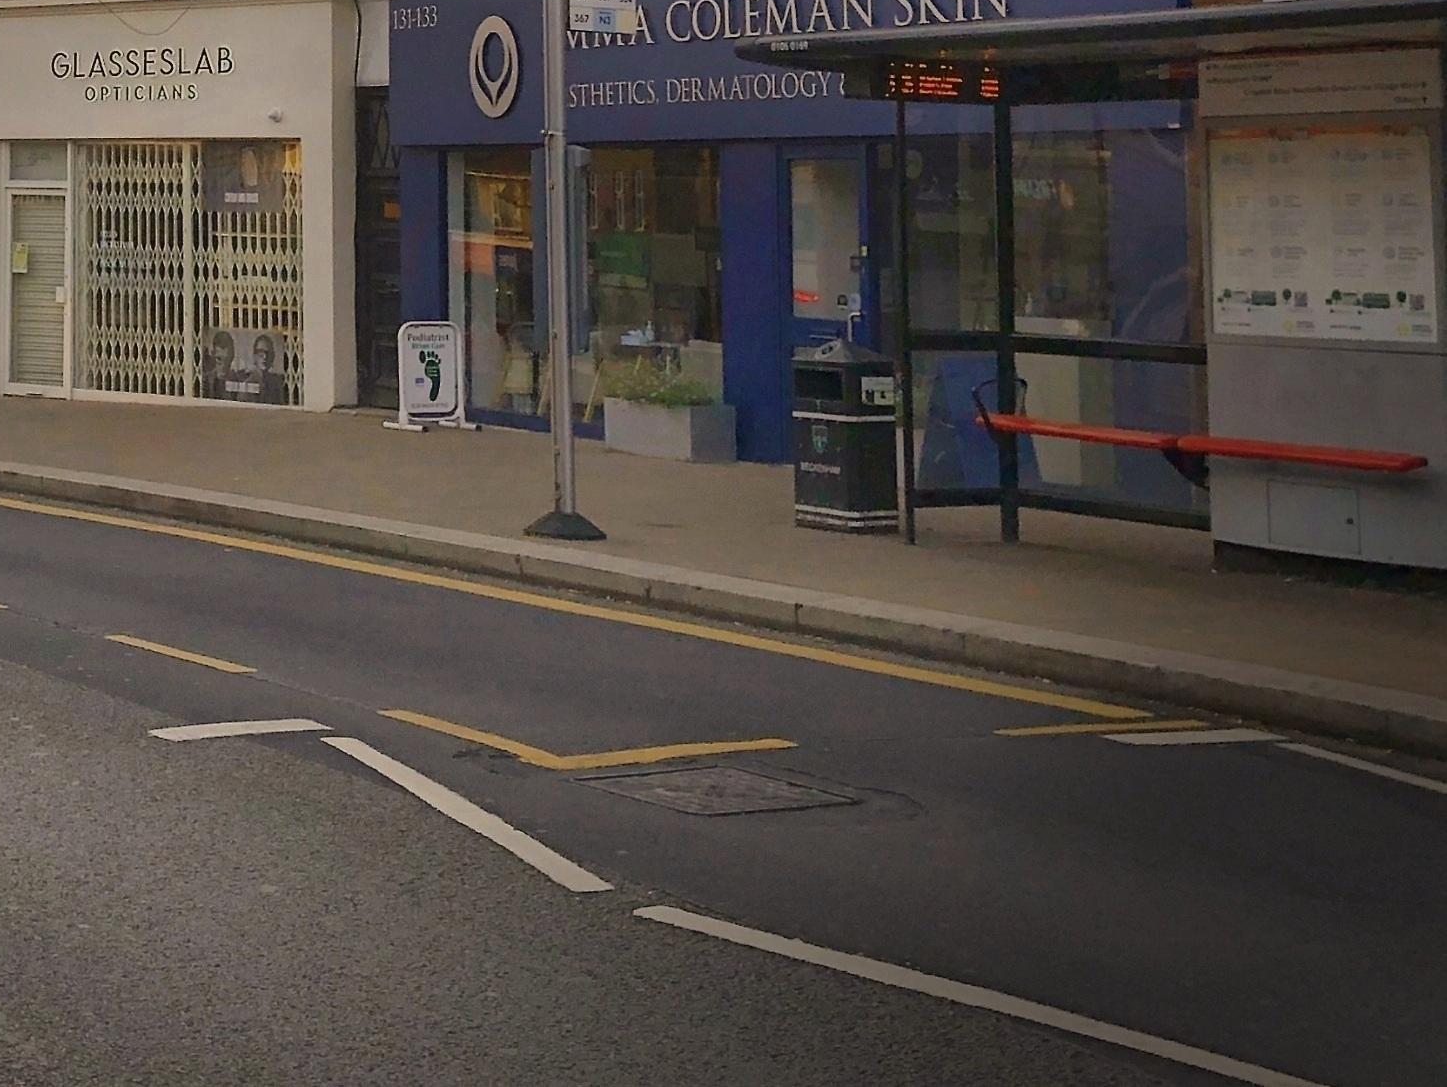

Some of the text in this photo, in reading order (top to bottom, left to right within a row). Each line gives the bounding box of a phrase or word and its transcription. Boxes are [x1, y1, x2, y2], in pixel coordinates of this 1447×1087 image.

[393, 5, 437, 30] 131-133
[574, 14, 589, 24] 367
[51, 46, 234, 79] GLASSESLAB
[85, 84, 199, 102] OPTICIANS
[666, 71, 831, 104] DERMATOLOGY
